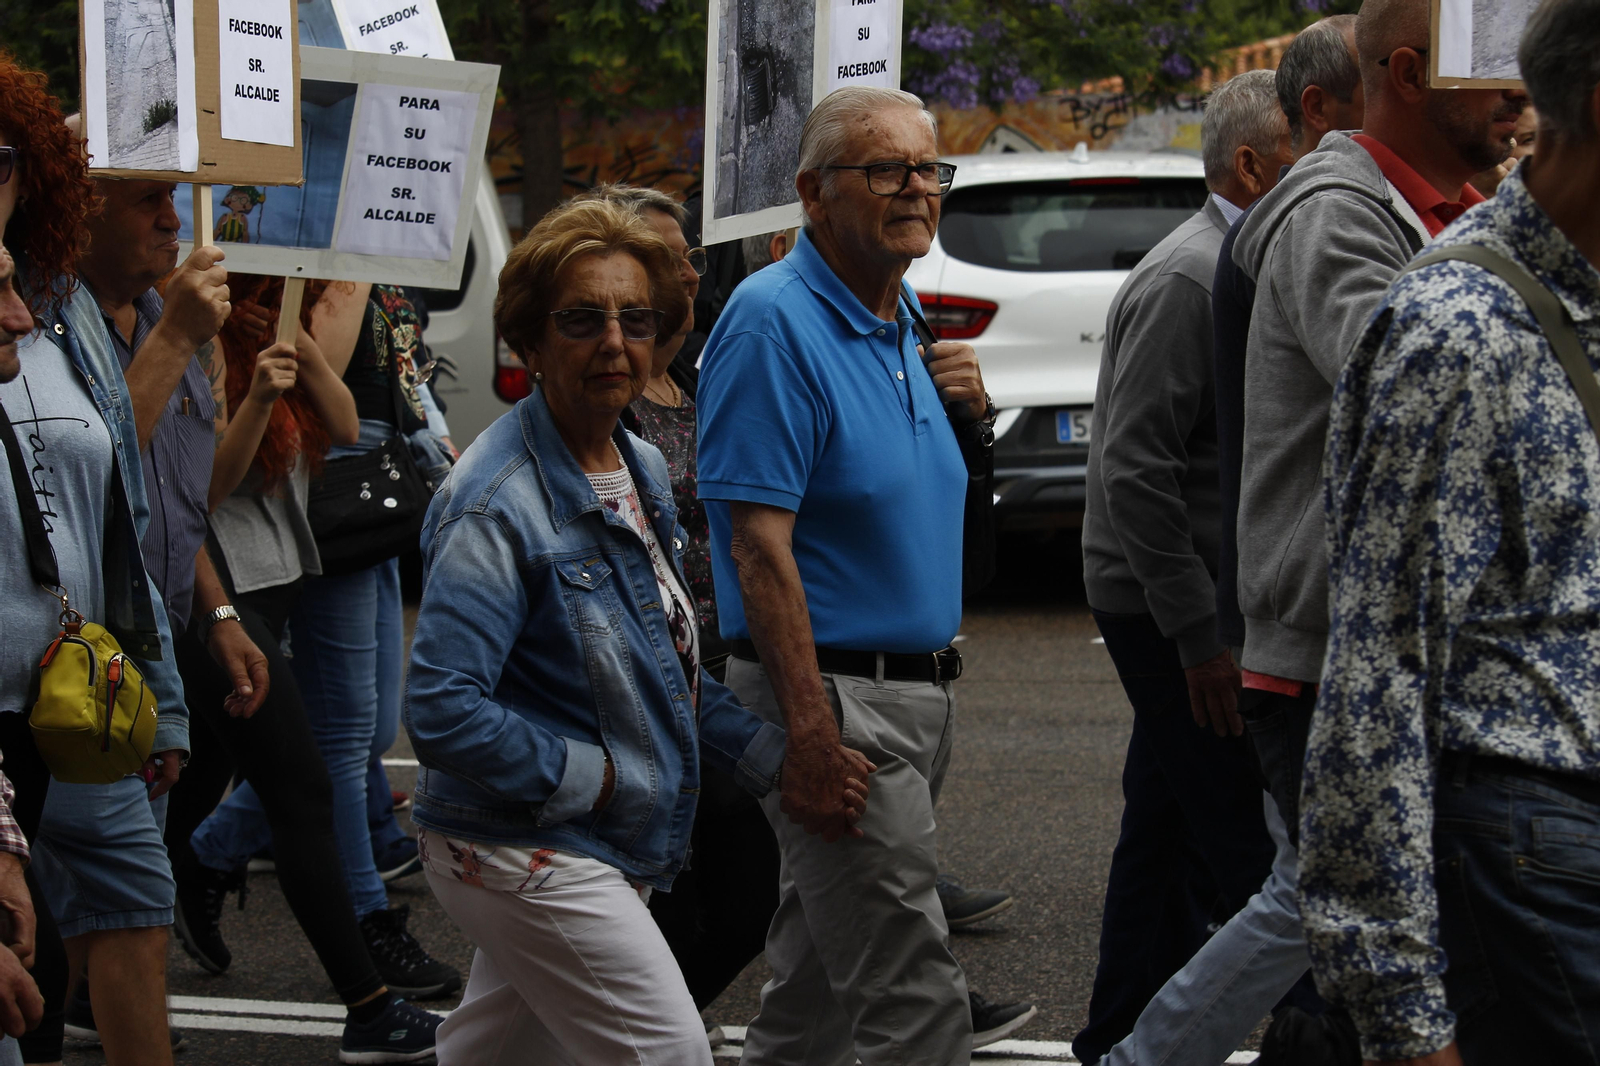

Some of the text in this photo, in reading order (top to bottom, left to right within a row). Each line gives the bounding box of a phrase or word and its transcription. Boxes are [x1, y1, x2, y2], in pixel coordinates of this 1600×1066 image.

[228, 18, 283, 40] FACEBOOK
[359, 4, 420, 37] FACEBOOK
[857, 27, 870, 41] SU
[389, 41, 409, 55] SR.
[248, 58, 265, 73] SR.
[837, 59, 887, 80] FACEBOOK
[234, 83, 280, 103] ALCALDE
[399, 96, 440, 111] PARA
[403, 127, 426, 140] SU
[366, 154, 452, 173] FACEBOOK
[390, 187, 416, 200] SR.
[363, 208, 436, 225] ALCALDE
[1073, 414, 1091, 438] 5
